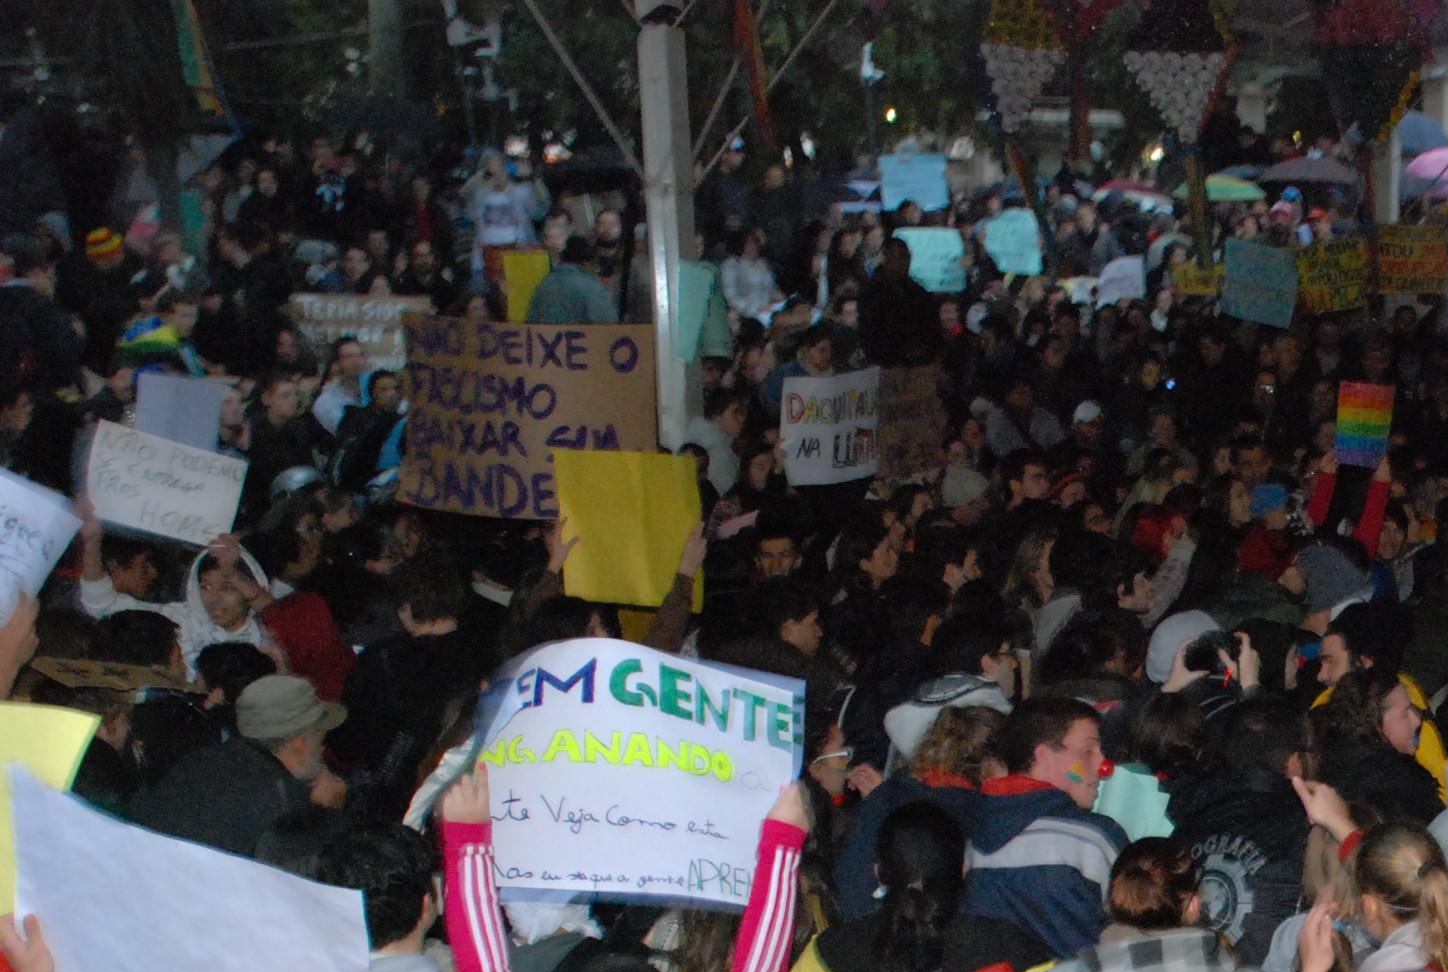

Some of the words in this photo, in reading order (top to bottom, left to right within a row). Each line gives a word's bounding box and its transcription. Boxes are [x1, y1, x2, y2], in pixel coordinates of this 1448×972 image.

[477, 324, 589, 371] DEIXE
[610, 336, 639, 374] O
[796, 436, 821, 459] NA
[405, 453, 560, 518] BANDE
[608, 657, 805, 754] GENTE
[479, 728, 737, 783] NGANANDO
[540, 793, 601, 834] Veja
[1188, 833, 1268, 877] OGRAFIA
